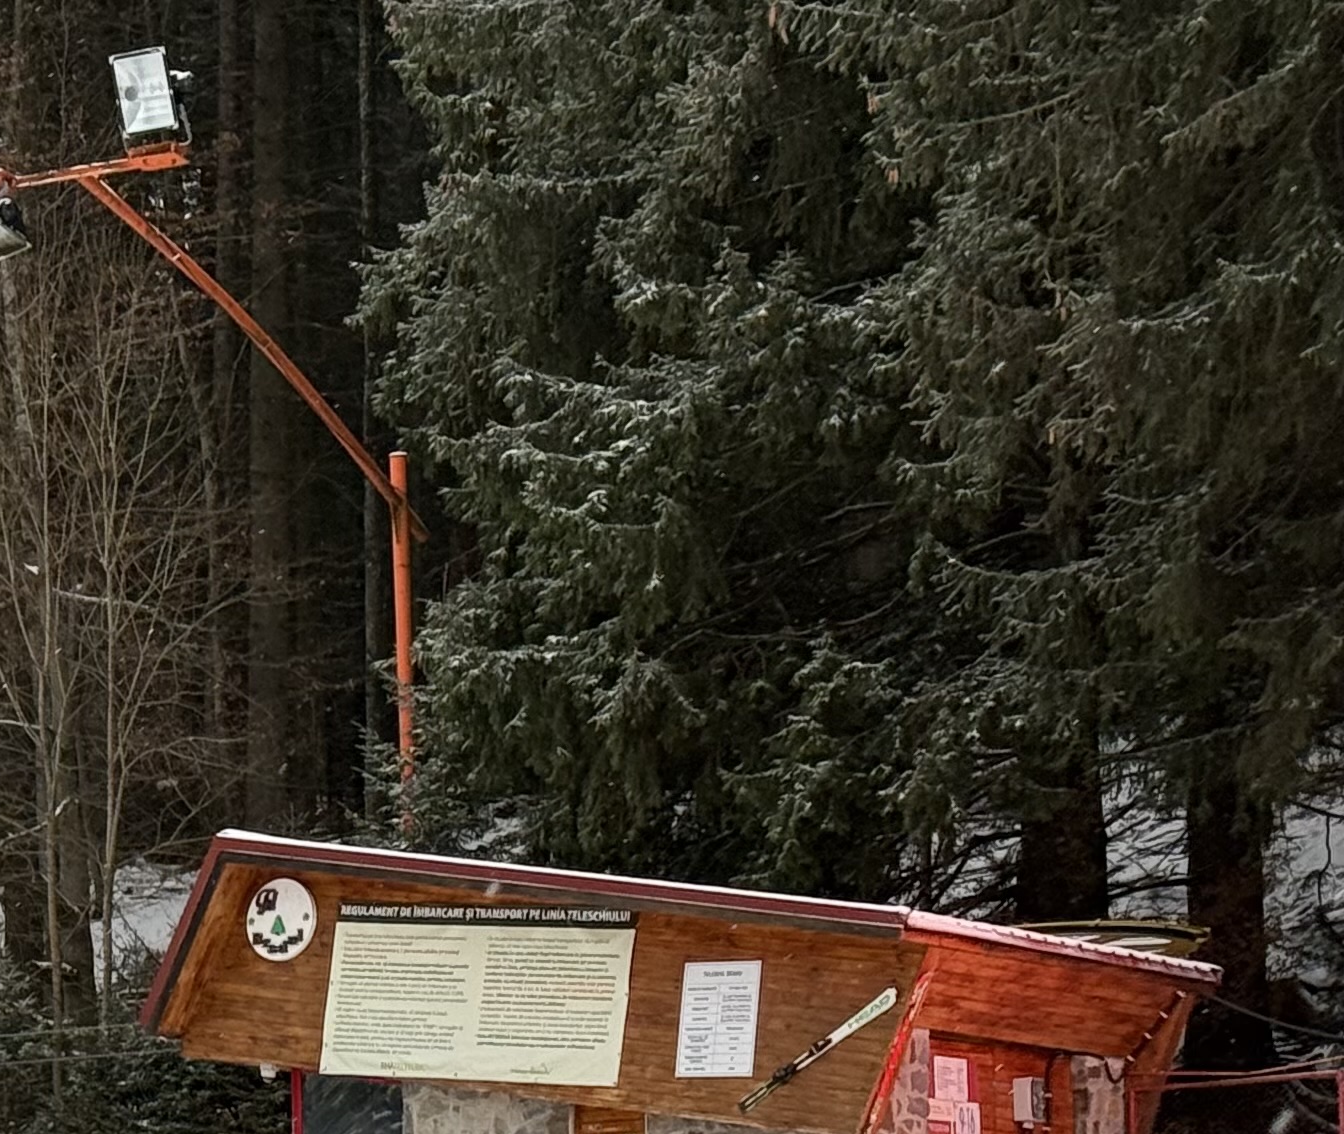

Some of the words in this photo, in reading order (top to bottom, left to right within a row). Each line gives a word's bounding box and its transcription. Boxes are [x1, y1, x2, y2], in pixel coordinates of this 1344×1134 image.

[340, 904, 398, 917] REGULAMENT
[400, 906, 412, 917] DE
[413, 903, 463, 918] ÎMBARCARE
[475, 908, 528, 920] TRANSPORT
[529, 909, 540, 920] PE
[542, 909, 566, 921] LINIA
[566, 910, 631, 922] TELESCHIULUI
[847, 994, 891, 1030] HEAD
